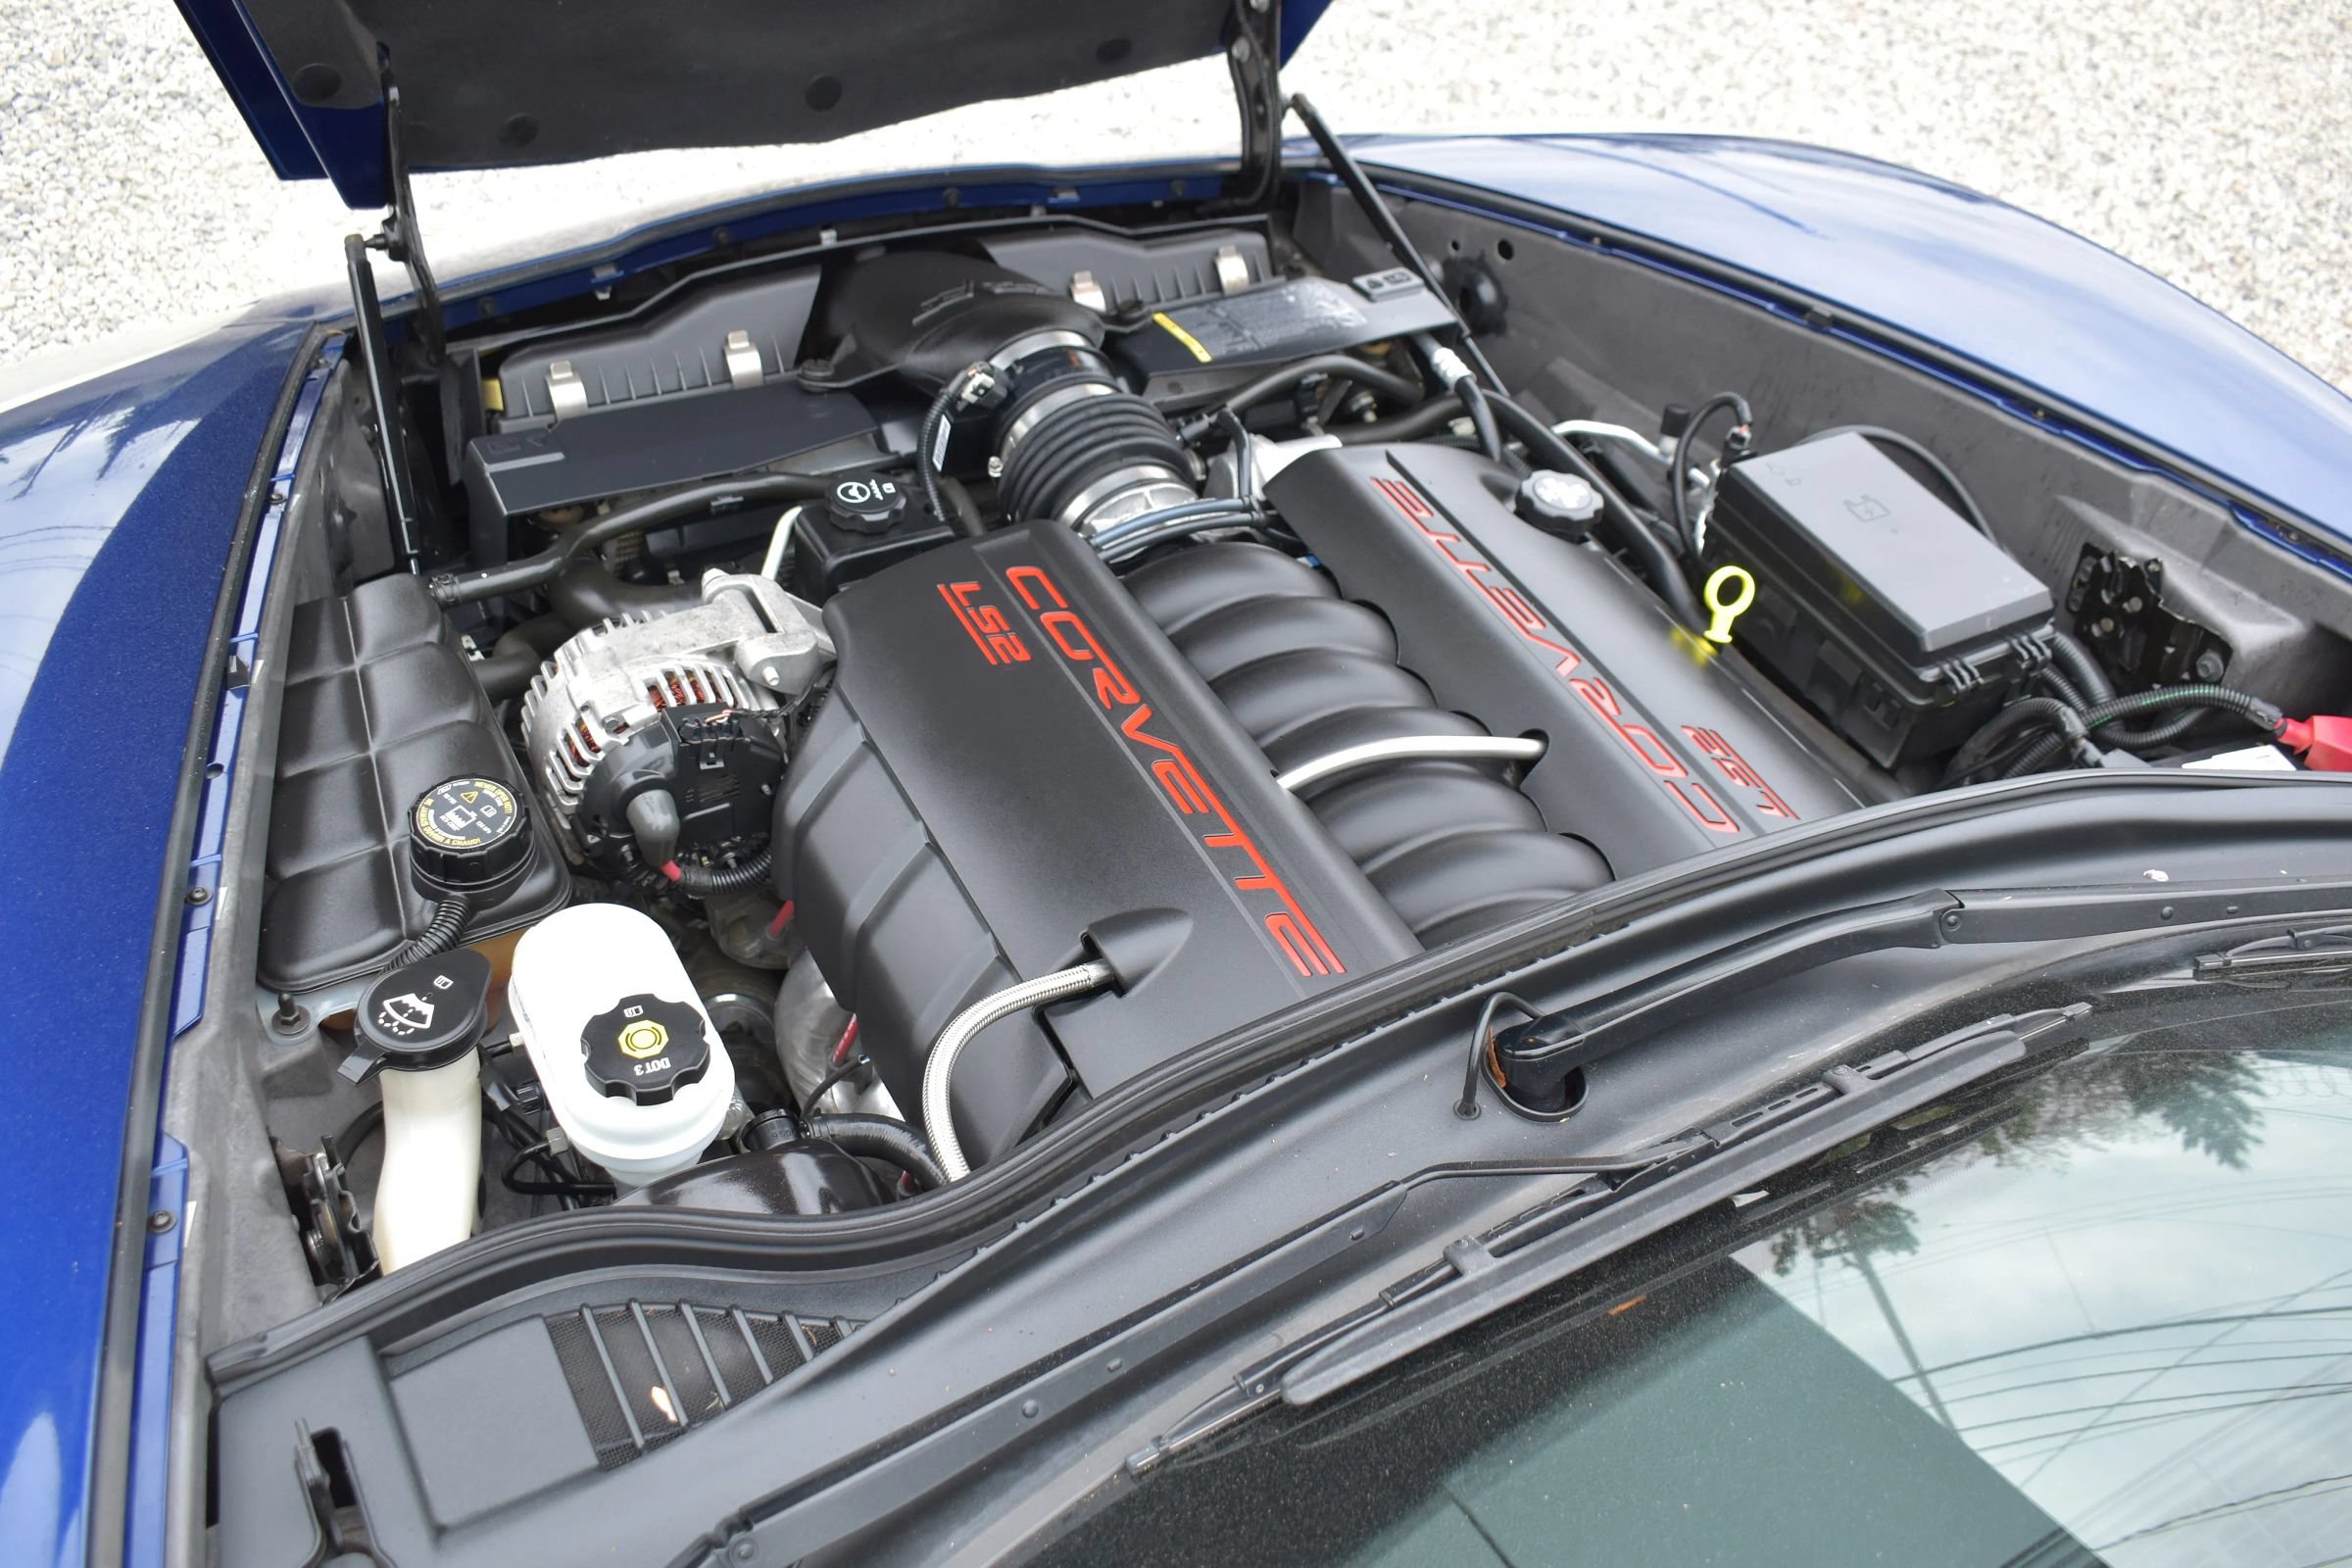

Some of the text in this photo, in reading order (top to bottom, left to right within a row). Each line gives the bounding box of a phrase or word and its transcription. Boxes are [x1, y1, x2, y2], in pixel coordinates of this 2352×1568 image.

[949, 581, 1032, 664] LS2
[1371, 476, 1740, 833] CORVETTE
[1005, 565, 1348, 977] CORVETTE
[1681, 725, 1789, 818] LS2
[633, 1056, 671, 1076] DOT 3
